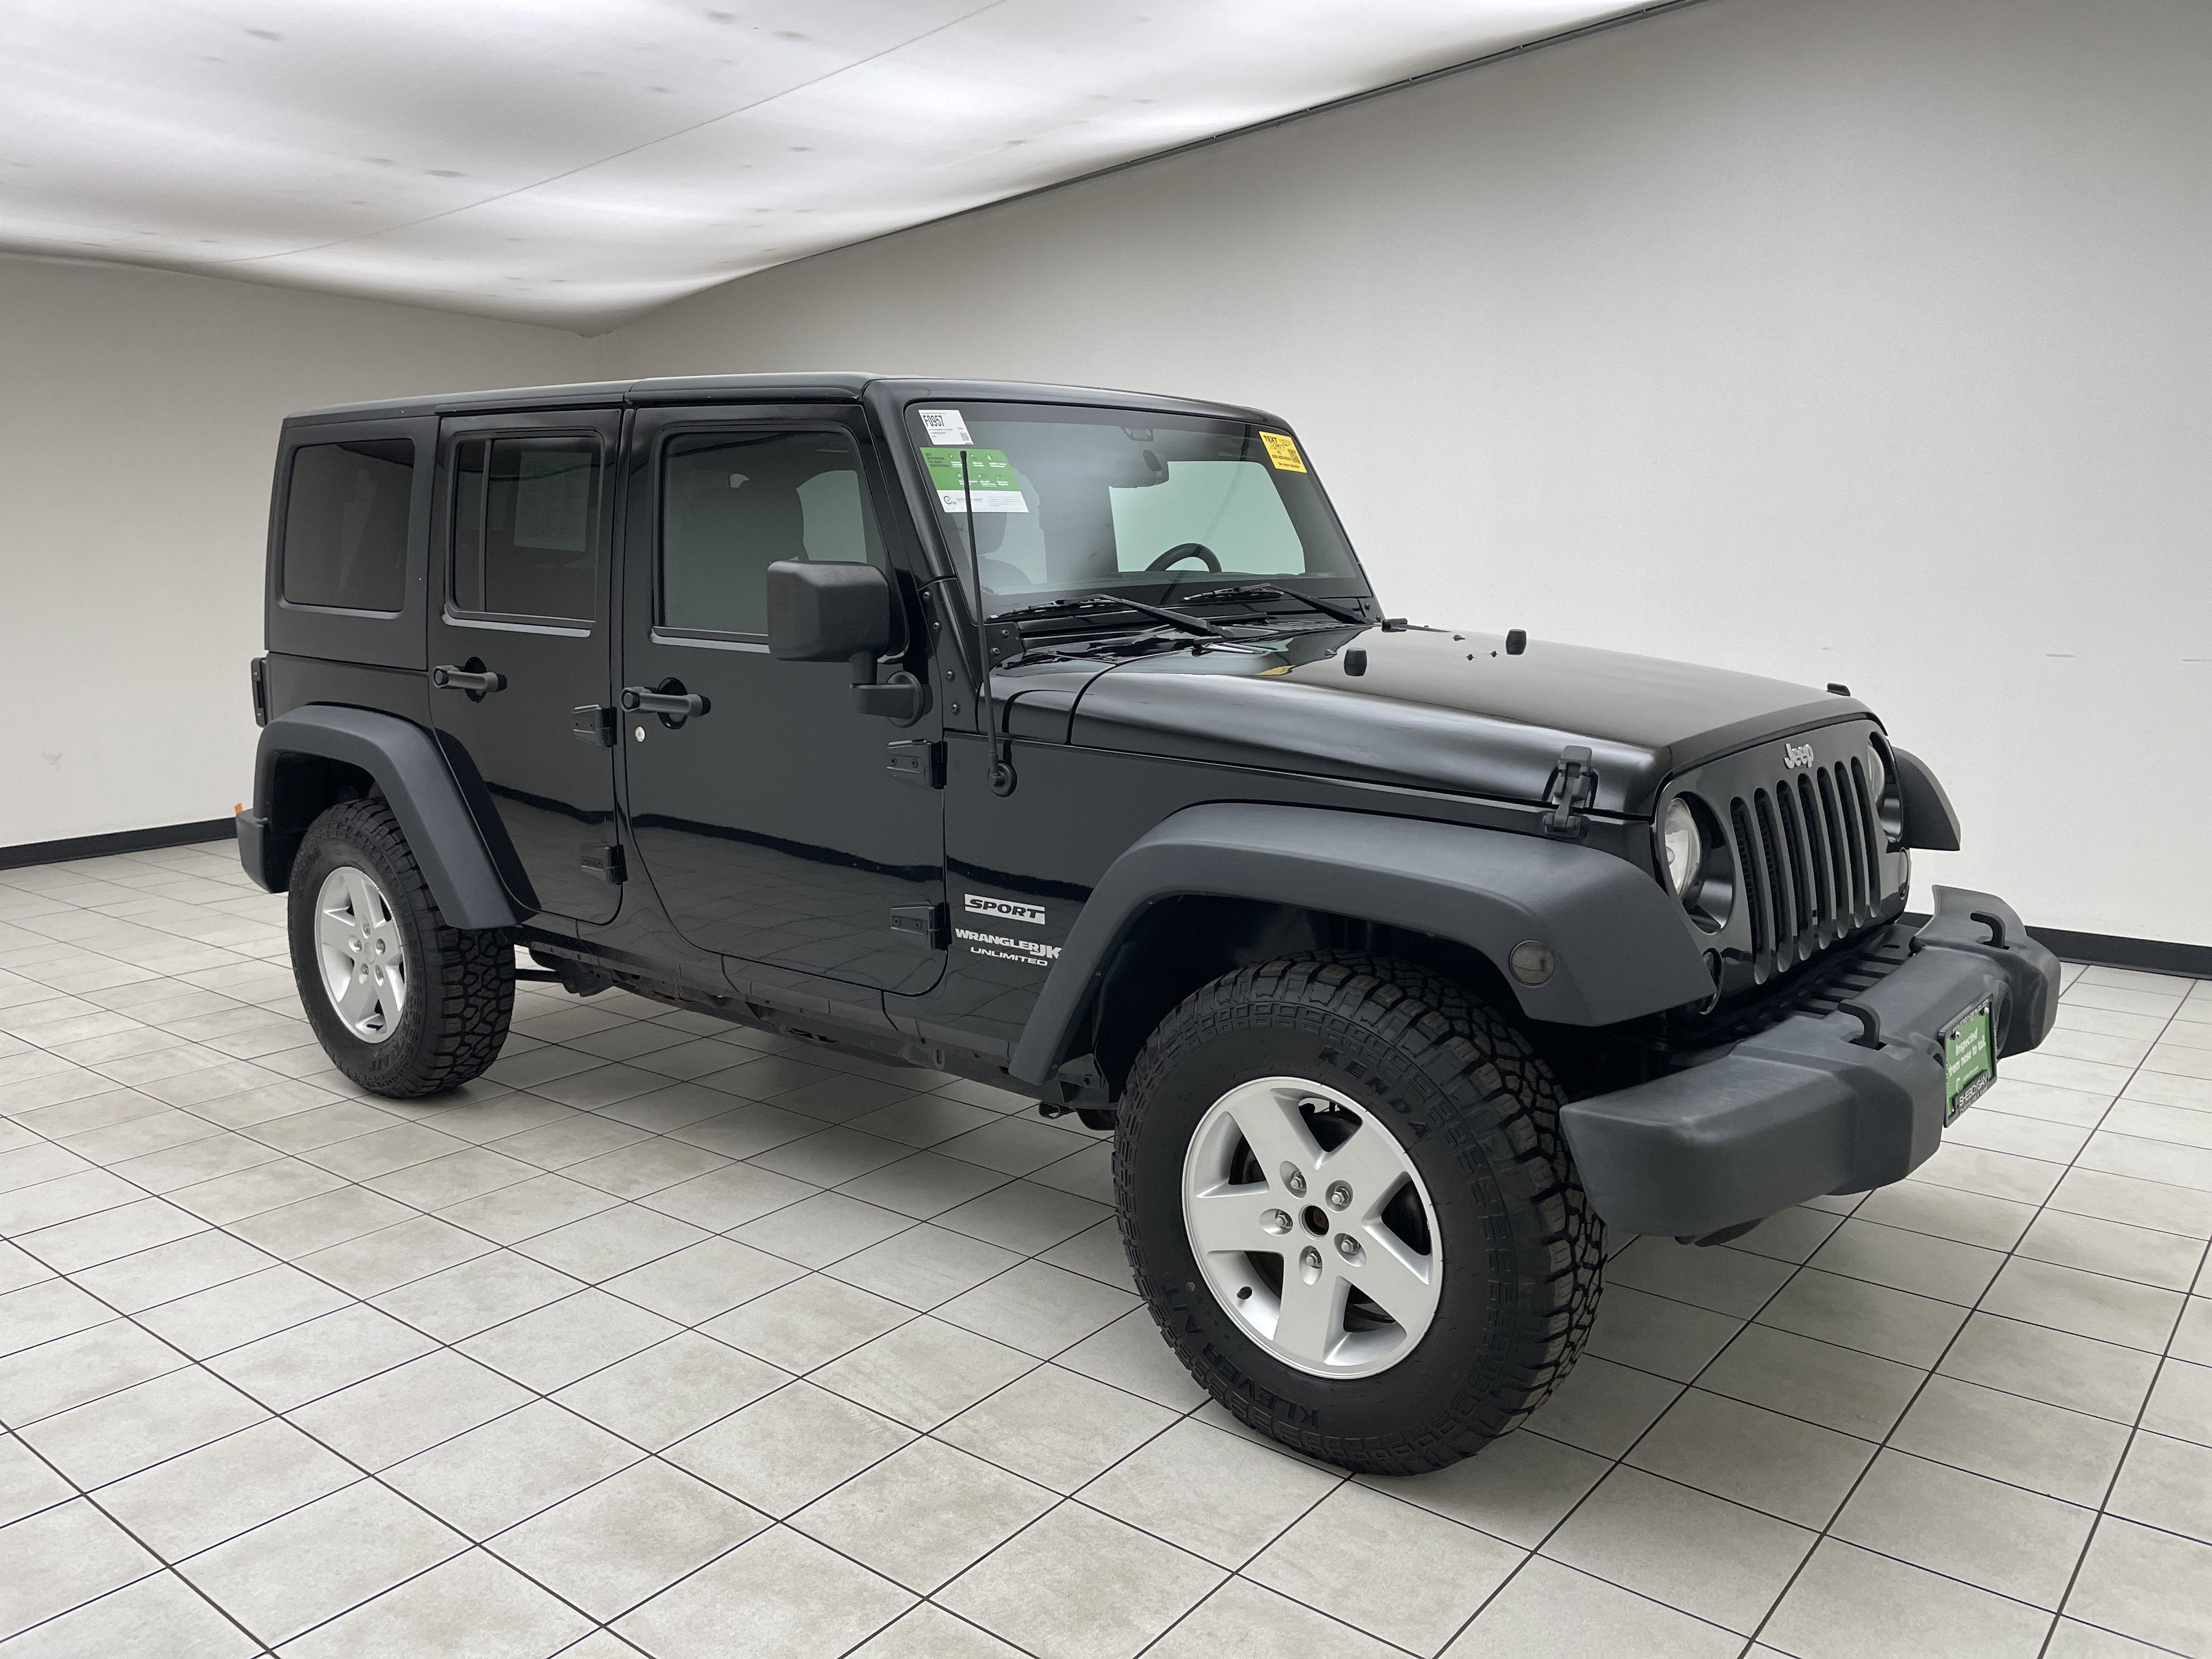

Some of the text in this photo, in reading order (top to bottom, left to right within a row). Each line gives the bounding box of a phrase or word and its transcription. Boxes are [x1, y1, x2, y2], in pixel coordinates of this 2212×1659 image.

[923, 415, 945, 427] F0957
[1784, 743, 1814, 769] Jeep
[966, 899, 1045, 918] SPORT
[970, 946, 1048, 967] UNLIMITED
[1955, 1026, 1978, 1057] Inspected
[1949, 1059, 1960, 1078] from
[1961, 1050, 1972, 1066] nose
[1972, 1045, 1978, 1056] to
[1318, 1045, 1432, 1139] KENDA
[1959, 1073, 1988, 1107] SHEBOYGAN
[1202, 1341, 1319, 1429] KLEVER
